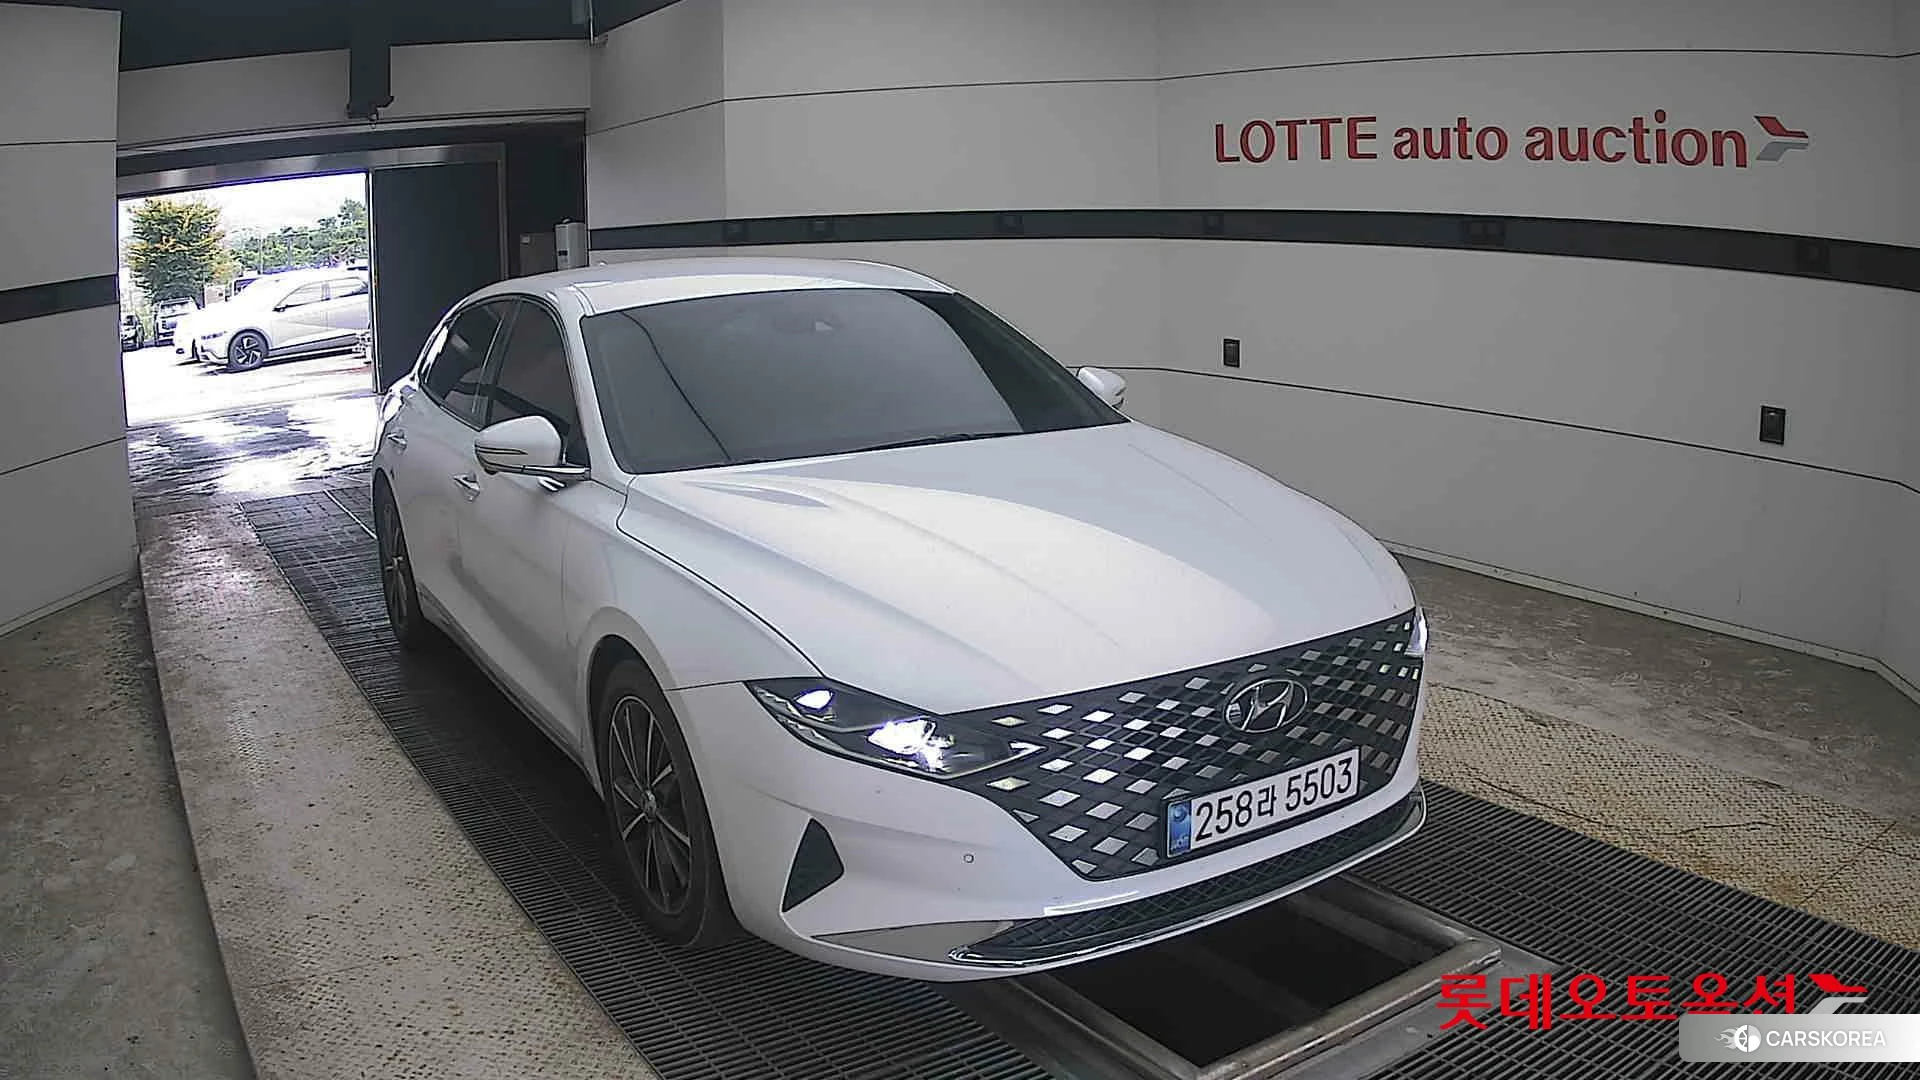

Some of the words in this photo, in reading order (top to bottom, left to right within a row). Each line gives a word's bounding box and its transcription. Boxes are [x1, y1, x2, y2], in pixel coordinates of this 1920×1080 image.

[1214, 115, 1378, 164] LOTTE
[1392, 116, 1509, 161] auto
[1523, 109, 1748, 168] auction
[1194, 784, 1277, 842] 258라
[1285, 757, 1353, 812] 5503
